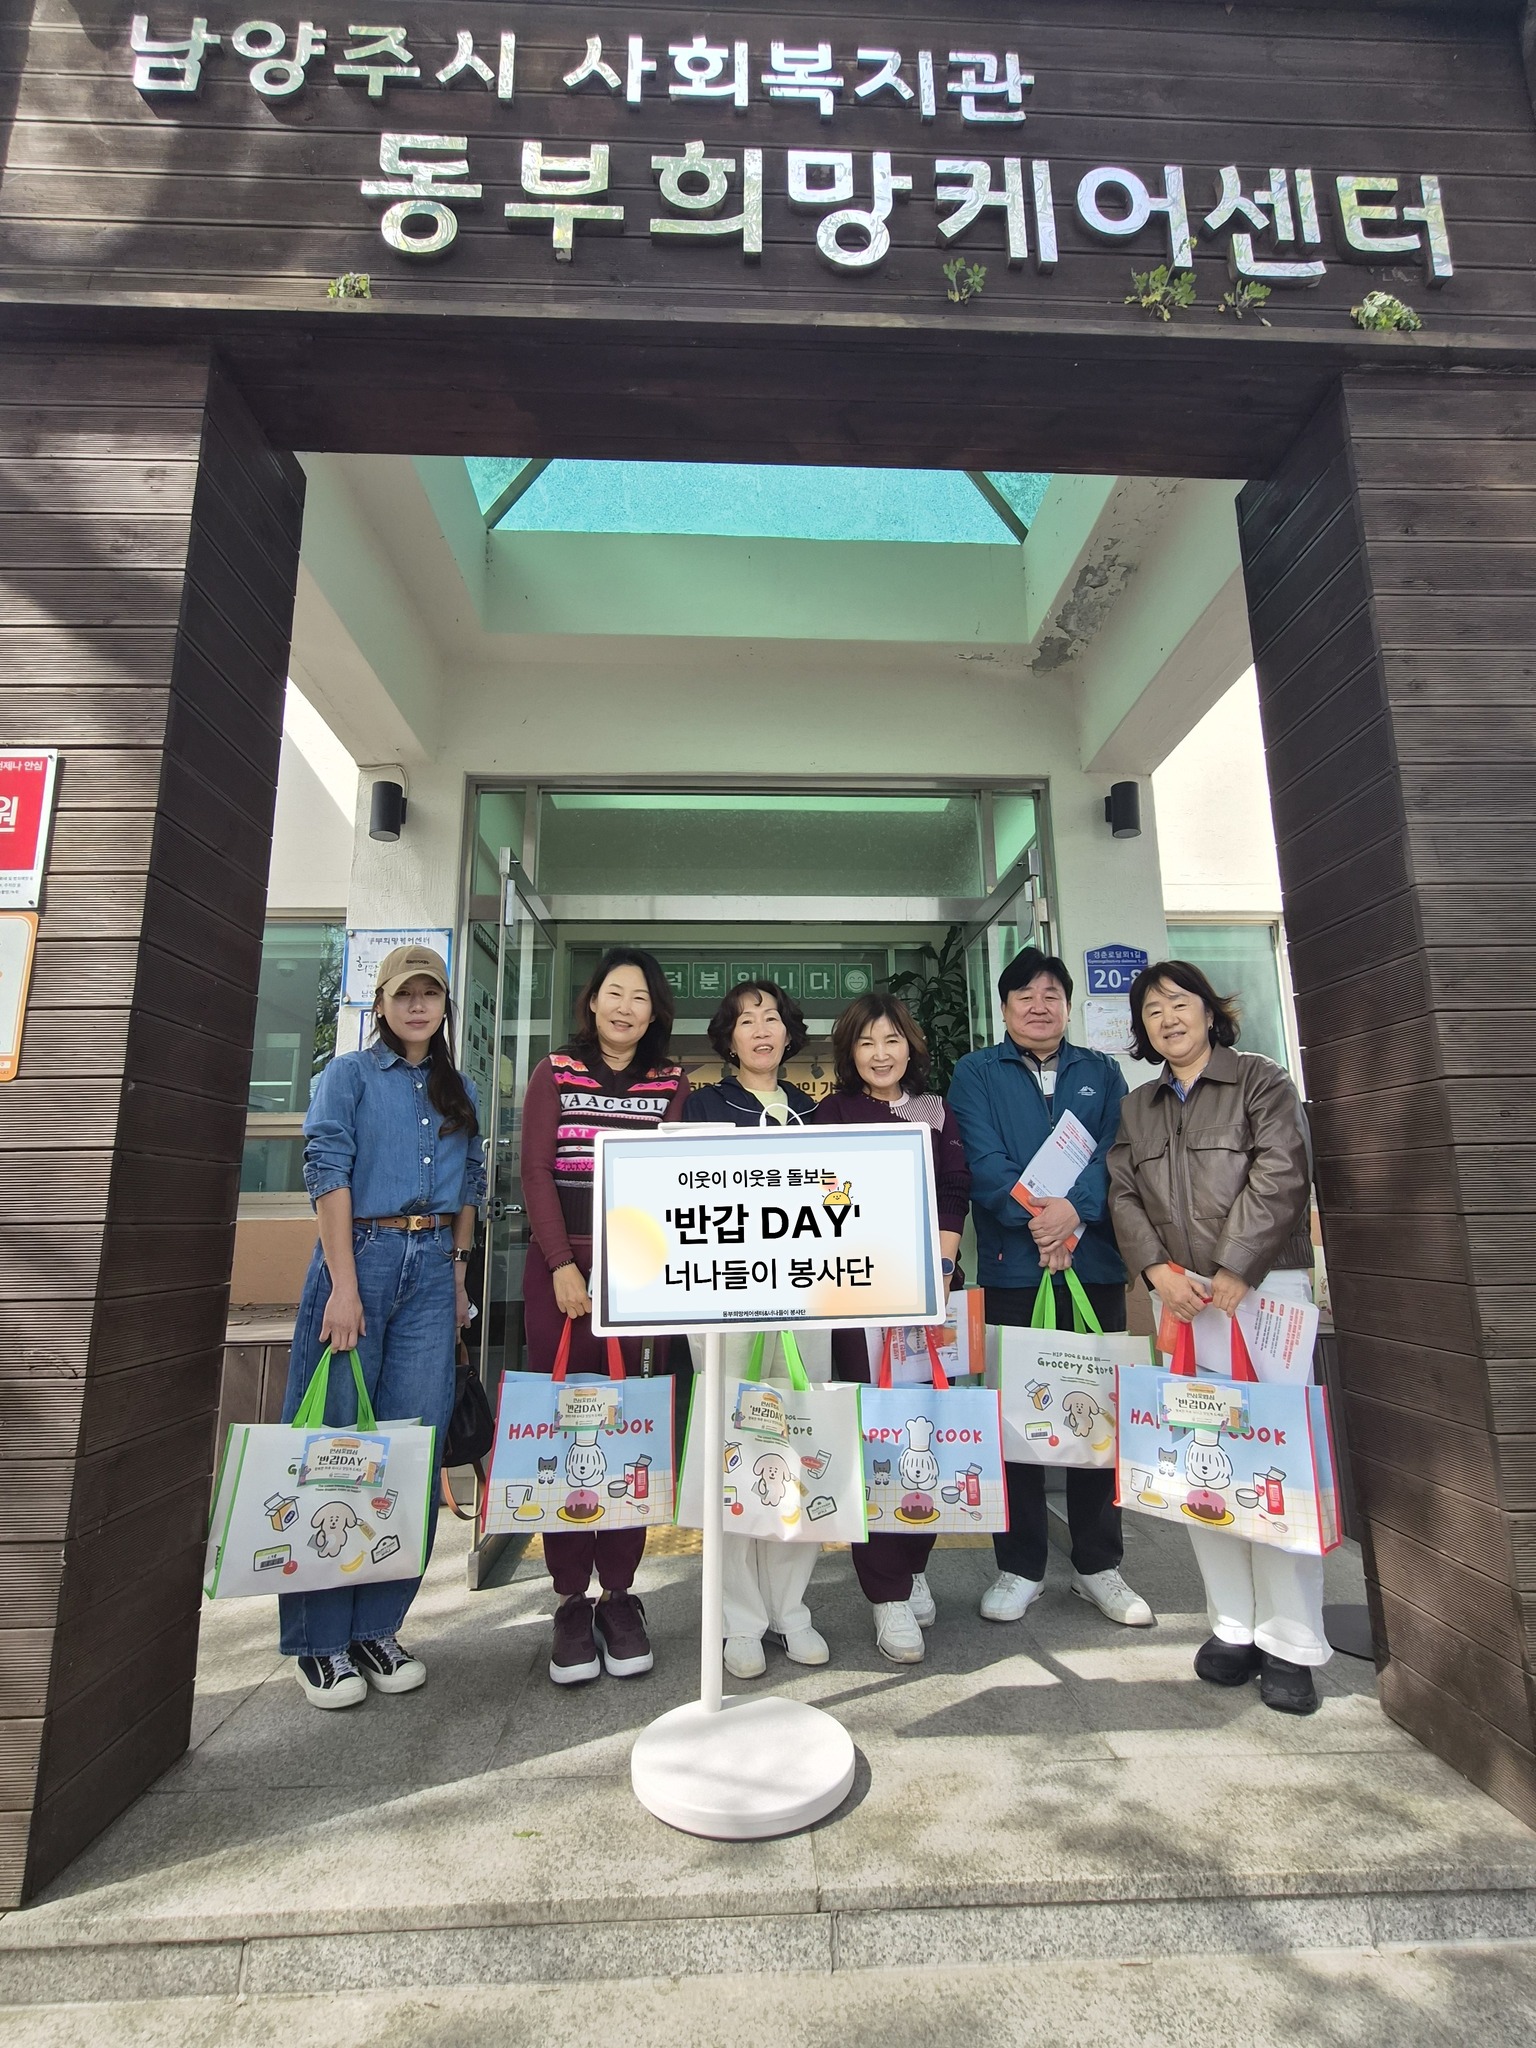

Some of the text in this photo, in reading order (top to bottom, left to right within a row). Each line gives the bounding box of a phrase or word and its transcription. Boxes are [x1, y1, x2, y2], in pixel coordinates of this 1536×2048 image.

[130, 14, 1035, 123] 남양주시 사회복지관
[361, 133, 1453, 281] 동부희망케어센터
[678, 1168, 837, 1188] 이웃이 이웃을 돌보는
[665, 1203, 861, 1245] '반갑 DAY'
[664, 1256, 874, 1291] 너나들이 봉사단
[1037, 1357, 1114, 1375] Grocery Store
[787, 1424, 813, 1436] tore
[935, 1428, 983, 1444] COOK
